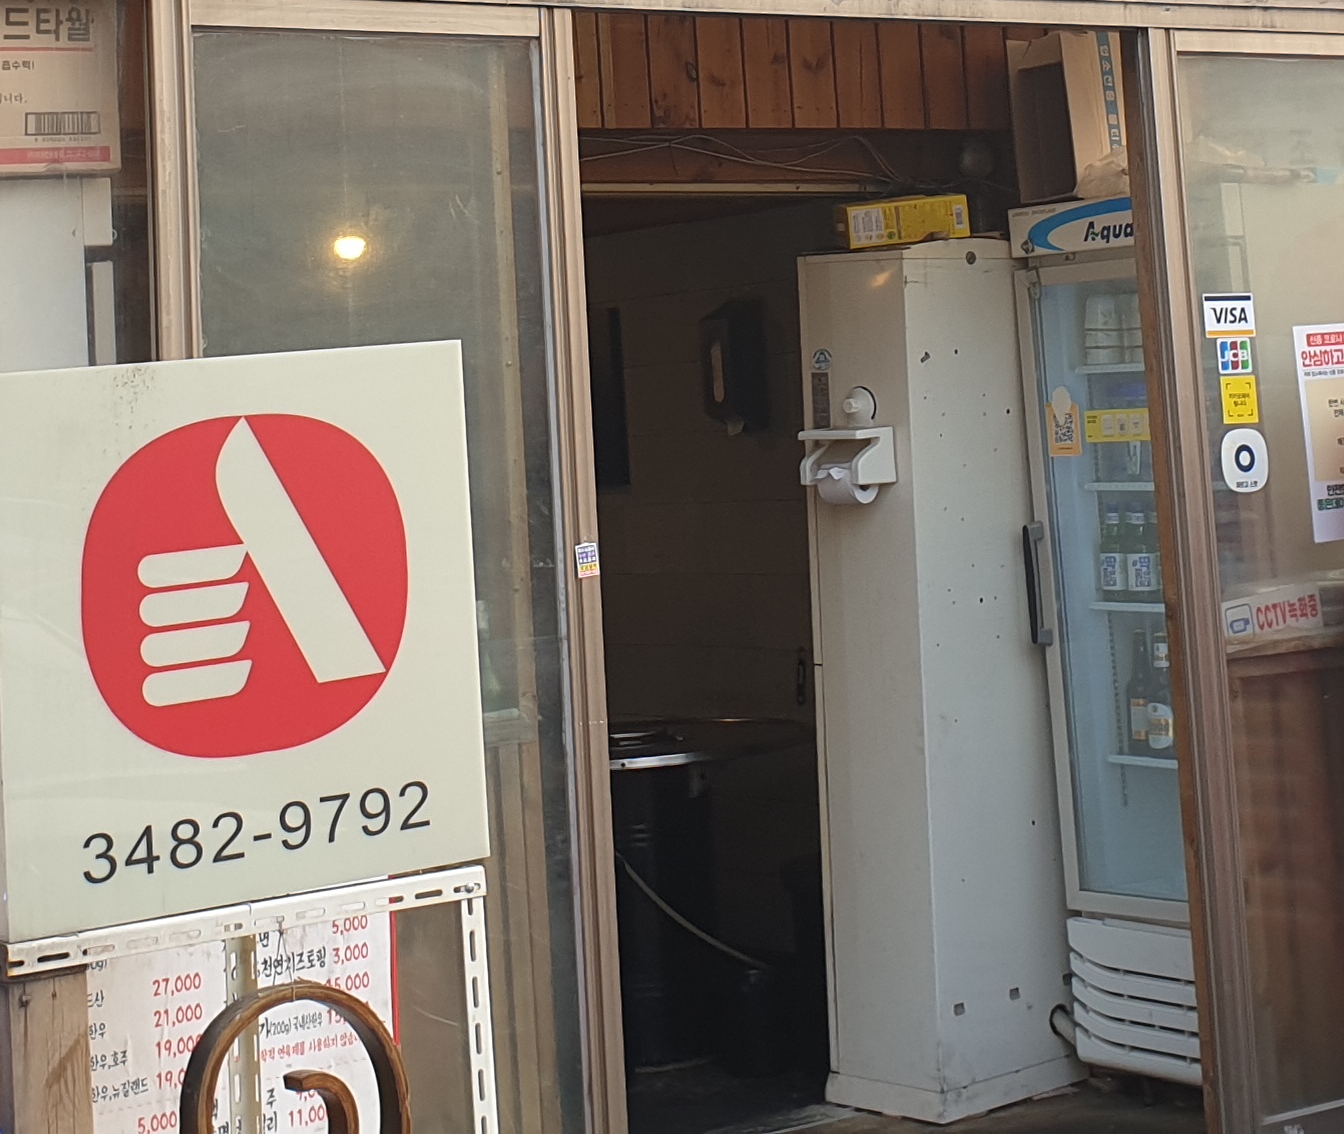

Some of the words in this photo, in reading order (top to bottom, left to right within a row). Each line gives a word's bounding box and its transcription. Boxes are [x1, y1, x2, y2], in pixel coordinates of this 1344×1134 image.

[1210, 307, 1249, 325] VISA
[1221, 349, 1249, 362] JCB
[81, 780, 432, 885] 3482-9792
[331, 915, 369, 935] 5,000
[332, 942, 370, 965] 3,000
[152, 971, 203, 997] 27,000
[153, 1002, 204, 1028] 21,000
[137, 1110, 179, 1134] 5,000
[288, 1104, 329, 1128] 11,00
